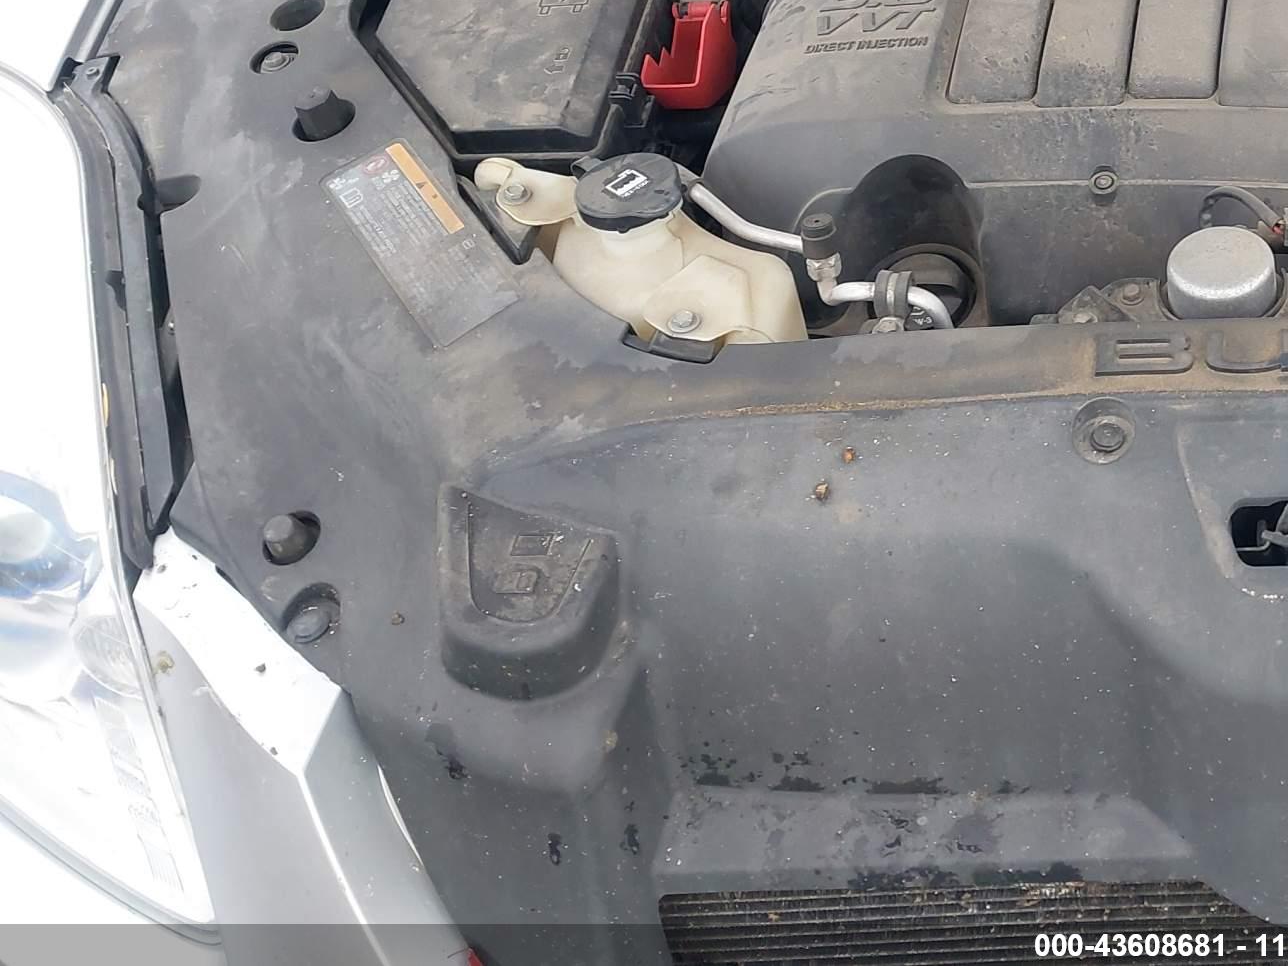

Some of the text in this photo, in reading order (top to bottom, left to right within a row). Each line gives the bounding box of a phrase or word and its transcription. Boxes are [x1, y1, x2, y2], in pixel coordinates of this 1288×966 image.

[816, 7, 937, 37] VVT
[803, 36, 929, 54] DIRECT INJECTION
